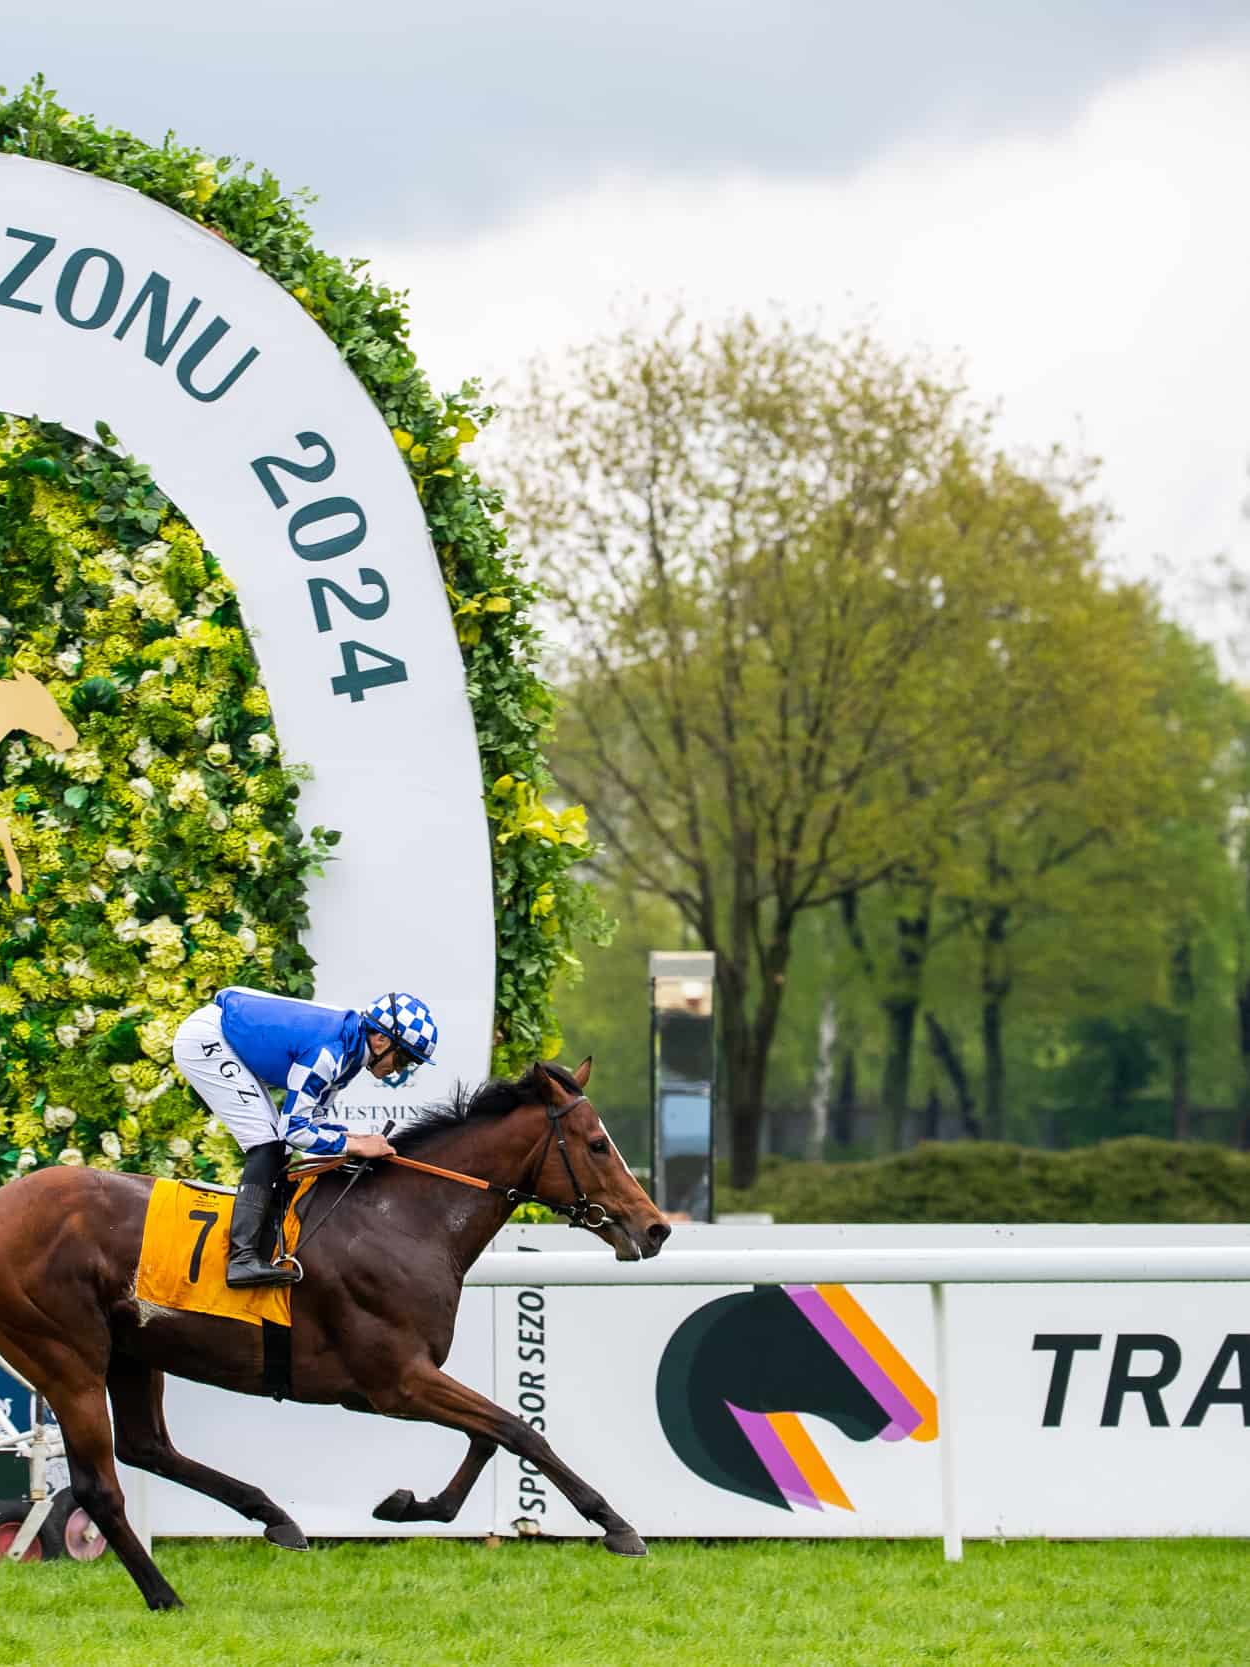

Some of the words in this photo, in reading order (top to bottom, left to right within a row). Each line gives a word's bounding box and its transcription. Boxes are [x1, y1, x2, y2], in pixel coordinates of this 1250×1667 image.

[249, 430, 409, 704] 2024
[188, 1209, 219, 1284] 7
[1032, 1333, 1250, 1428] TRA
